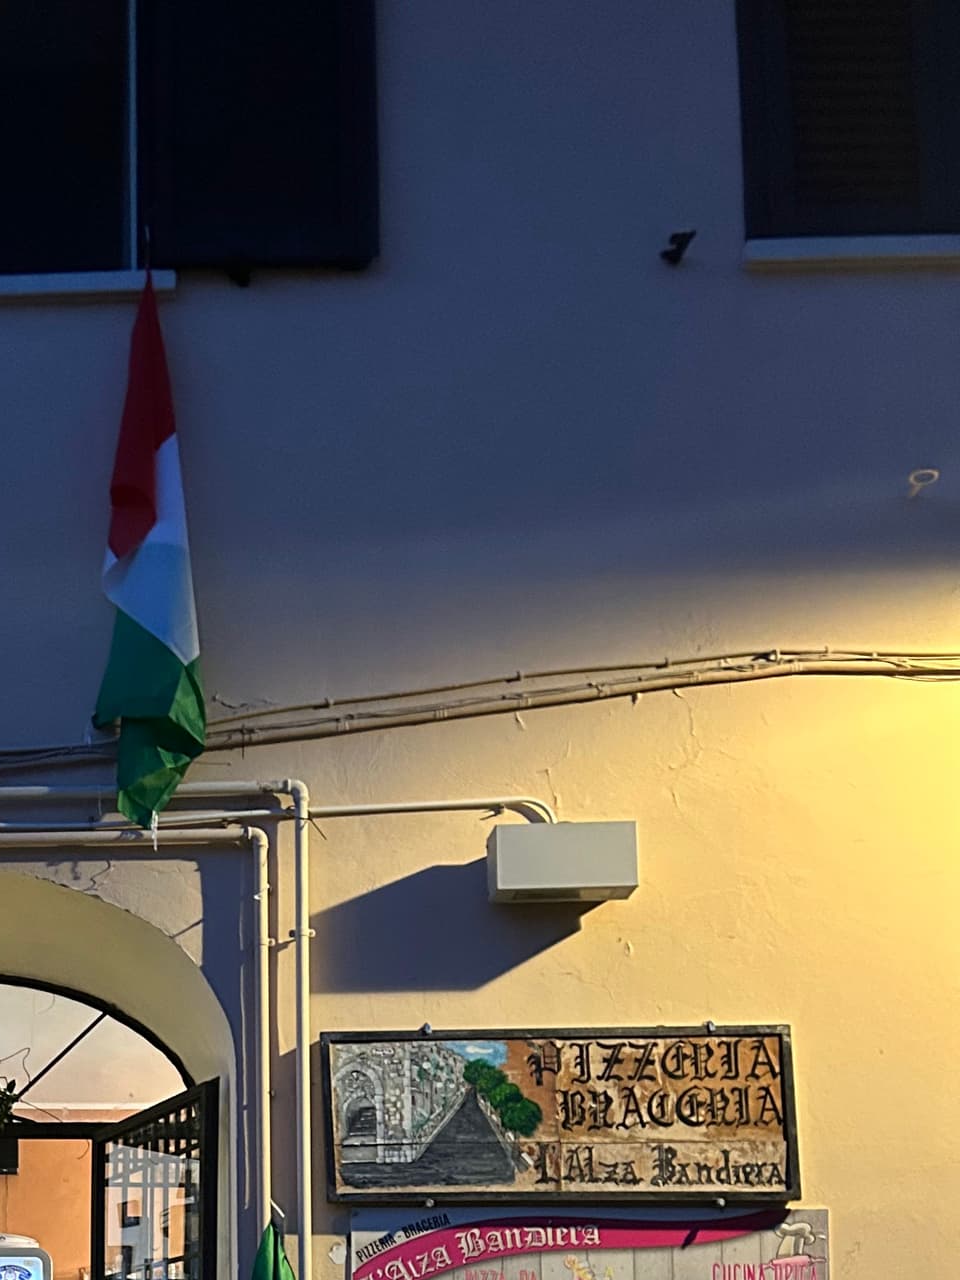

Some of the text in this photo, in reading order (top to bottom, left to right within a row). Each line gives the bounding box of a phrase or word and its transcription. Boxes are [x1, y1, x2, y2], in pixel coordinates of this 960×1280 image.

[527, 1039, 782, 1086] PIZZERIA
[557, 1084, 785, 1132] BRACERIA
[356, 1233, 397, 1263] PIZZERIA
[401, 1213, 451, 1239] BRACERIA
